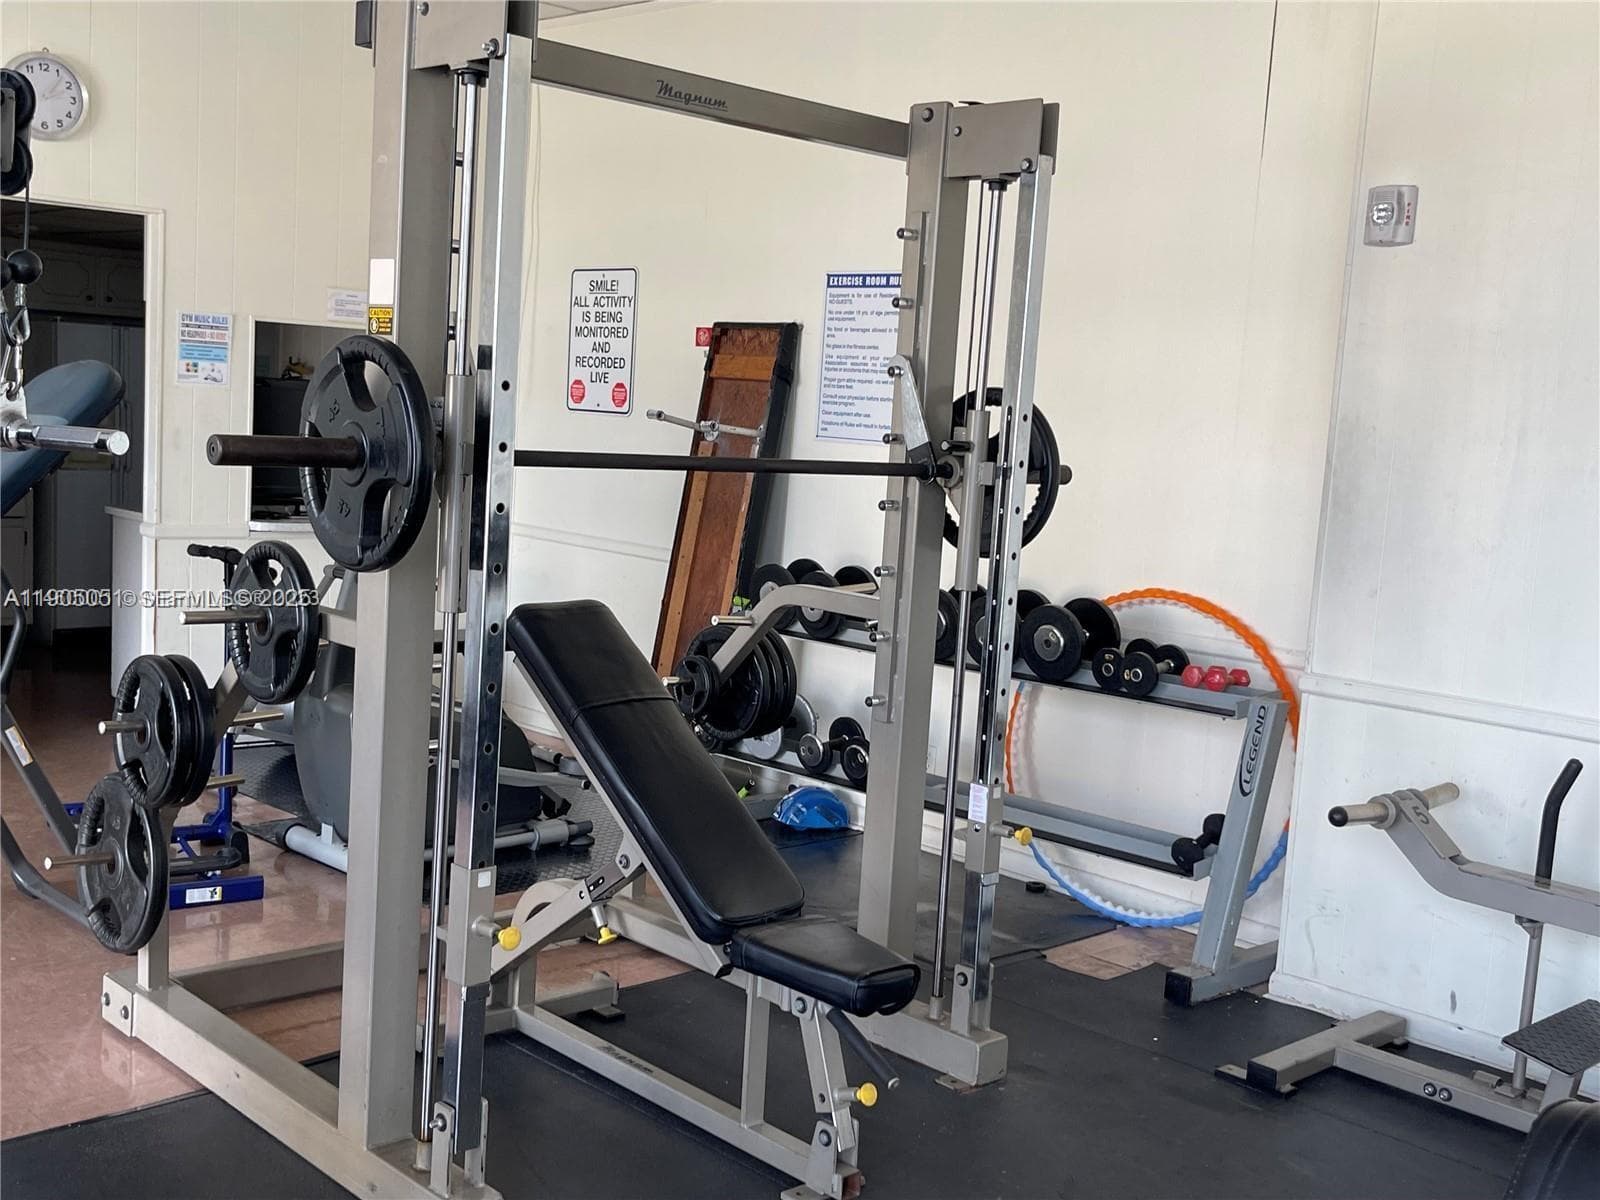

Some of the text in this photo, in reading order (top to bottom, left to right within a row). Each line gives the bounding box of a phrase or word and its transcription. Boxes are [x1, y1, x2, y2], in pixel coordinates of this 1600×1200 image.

[26, 64, 34, 74] 11
[39, 62, 50, 72] 12
[56, 68, 60, 78] 1
[65, 82, 72, 90] 2
[656, 80, 728, 109] Magnum
[70, 96, 77, 105] 3
[66, 110, 72, 119] 4
[41, 121, 48, 130] 6
[56, 120, 64, 128] 5
[589, 280, 619, 292] SMILE!
[829, 276, 864, 286] EXERCISE
[866, 276, 887, 286] ROOM
[573, 296, 633, 308] ALL ACTIVITY
[182, 314, 228, 325] GYM MUSIC RULES
[582, 311, 623, 323] IS BEING
[575, 326, 628, 339] MONITORED
[592, 342, 611, 353] AND
[575, 356, 625, 369] RECORDED
[590, 372, 609, 384] LIVE
[1243, 704, 1266, 784] LEGEND
[1412, 806, 1430, 824] 5
